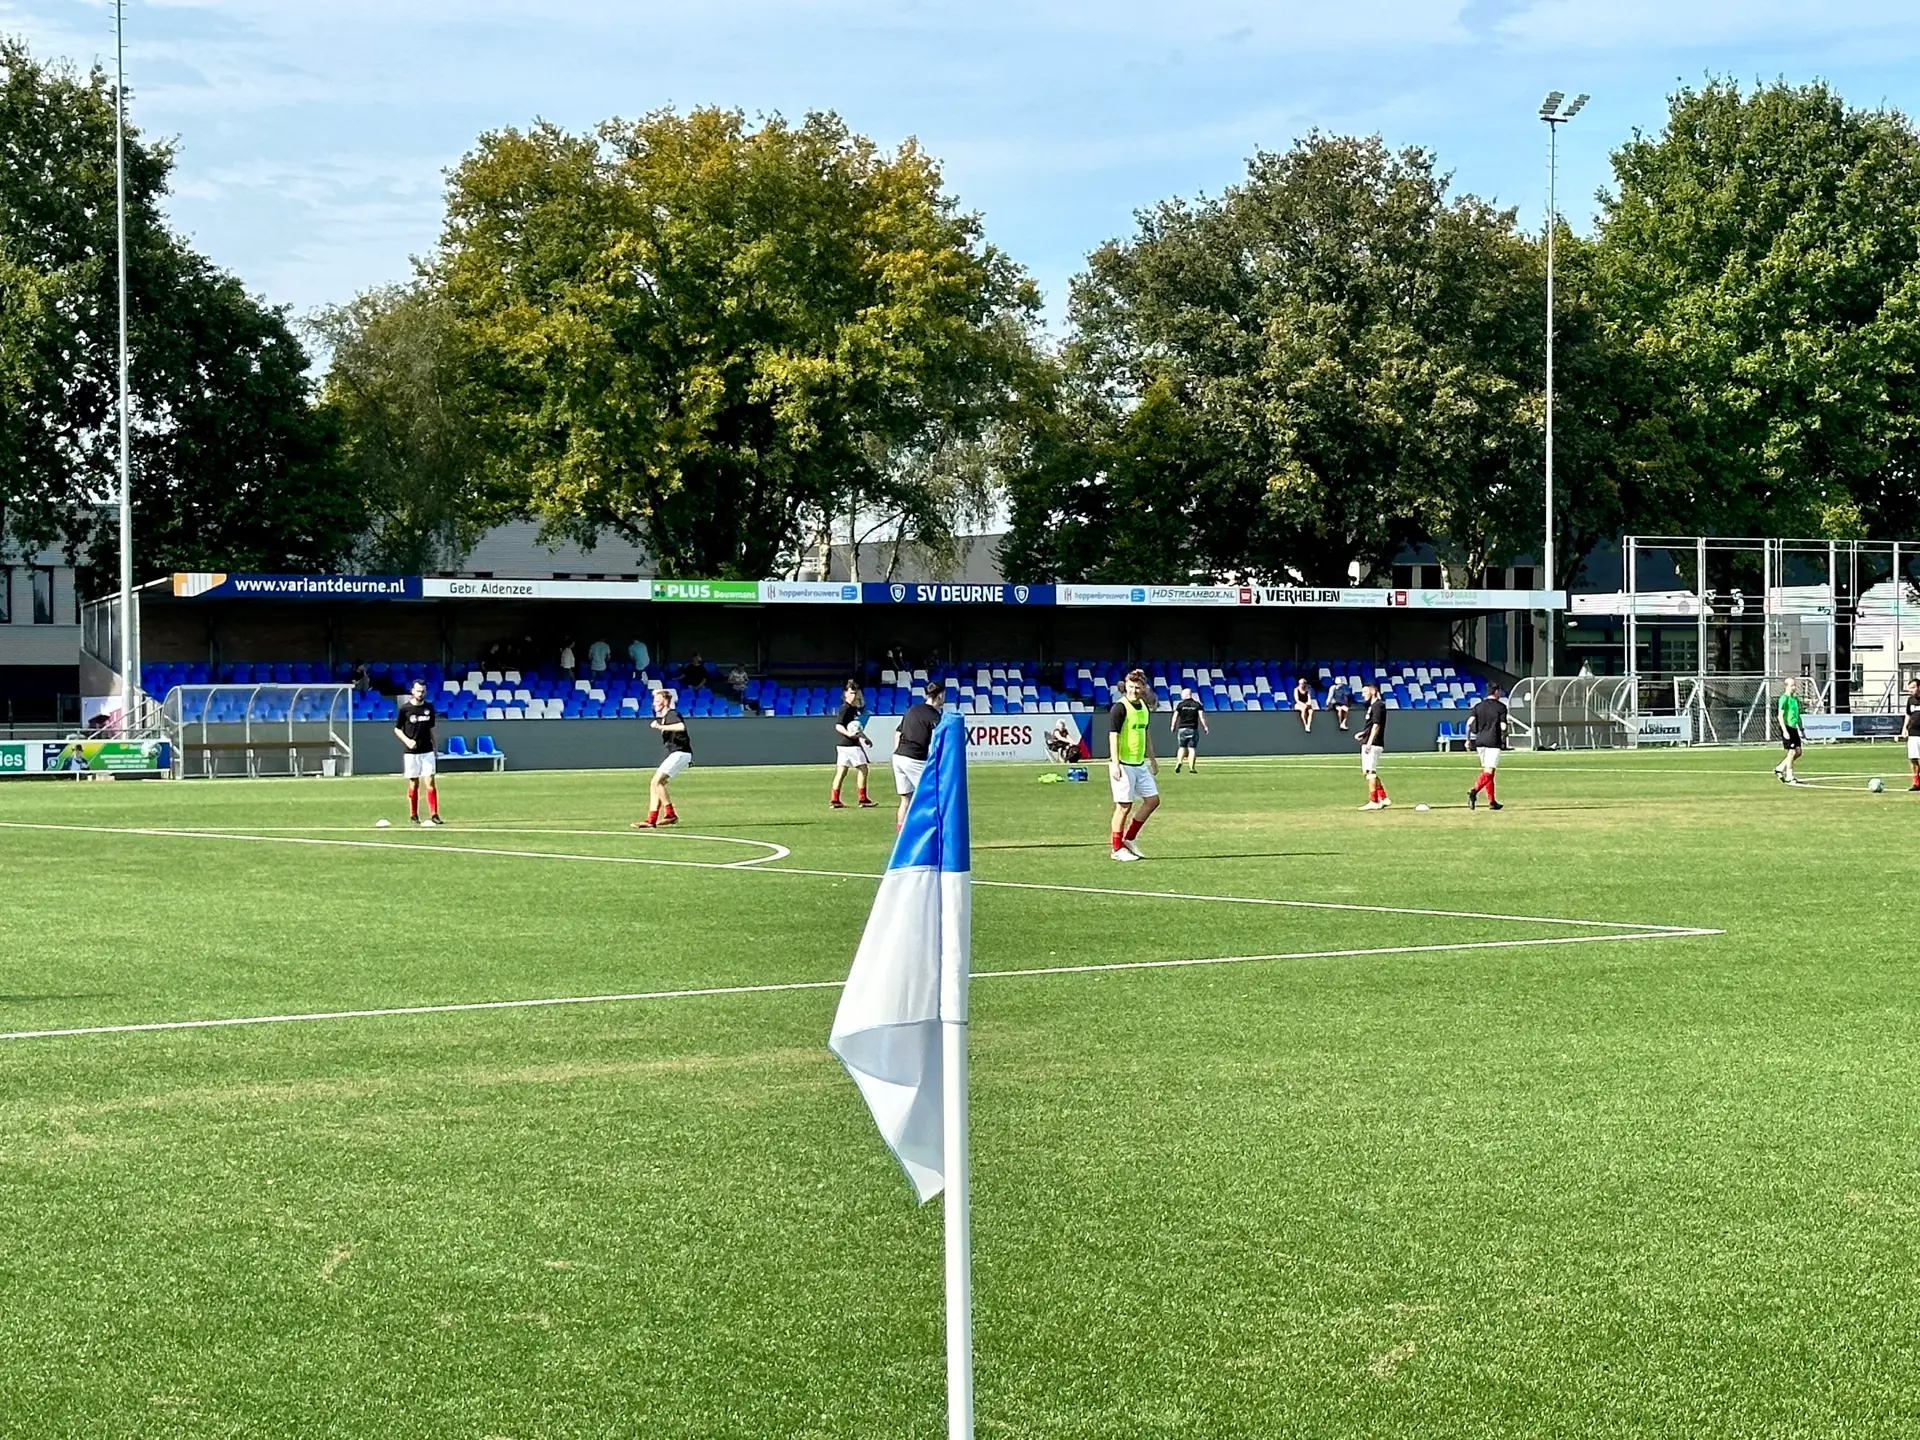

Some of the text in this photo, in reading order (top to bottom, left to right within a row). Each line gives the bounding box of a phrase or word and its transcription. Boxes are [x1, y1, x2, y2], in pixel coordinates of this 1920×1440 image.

[235, 578, 405, 594] www.variantdeurne.nl
[450, 582, 533, 595] Gebr. Aldenzee
[668, 584, 711, 598] PLUS
[779, 589, 840, 598] hoppenbrouwers
[917, 585, 1004, 602] SV DEURNE
[1266, 589, 1340, 604] VERHEIJEN
